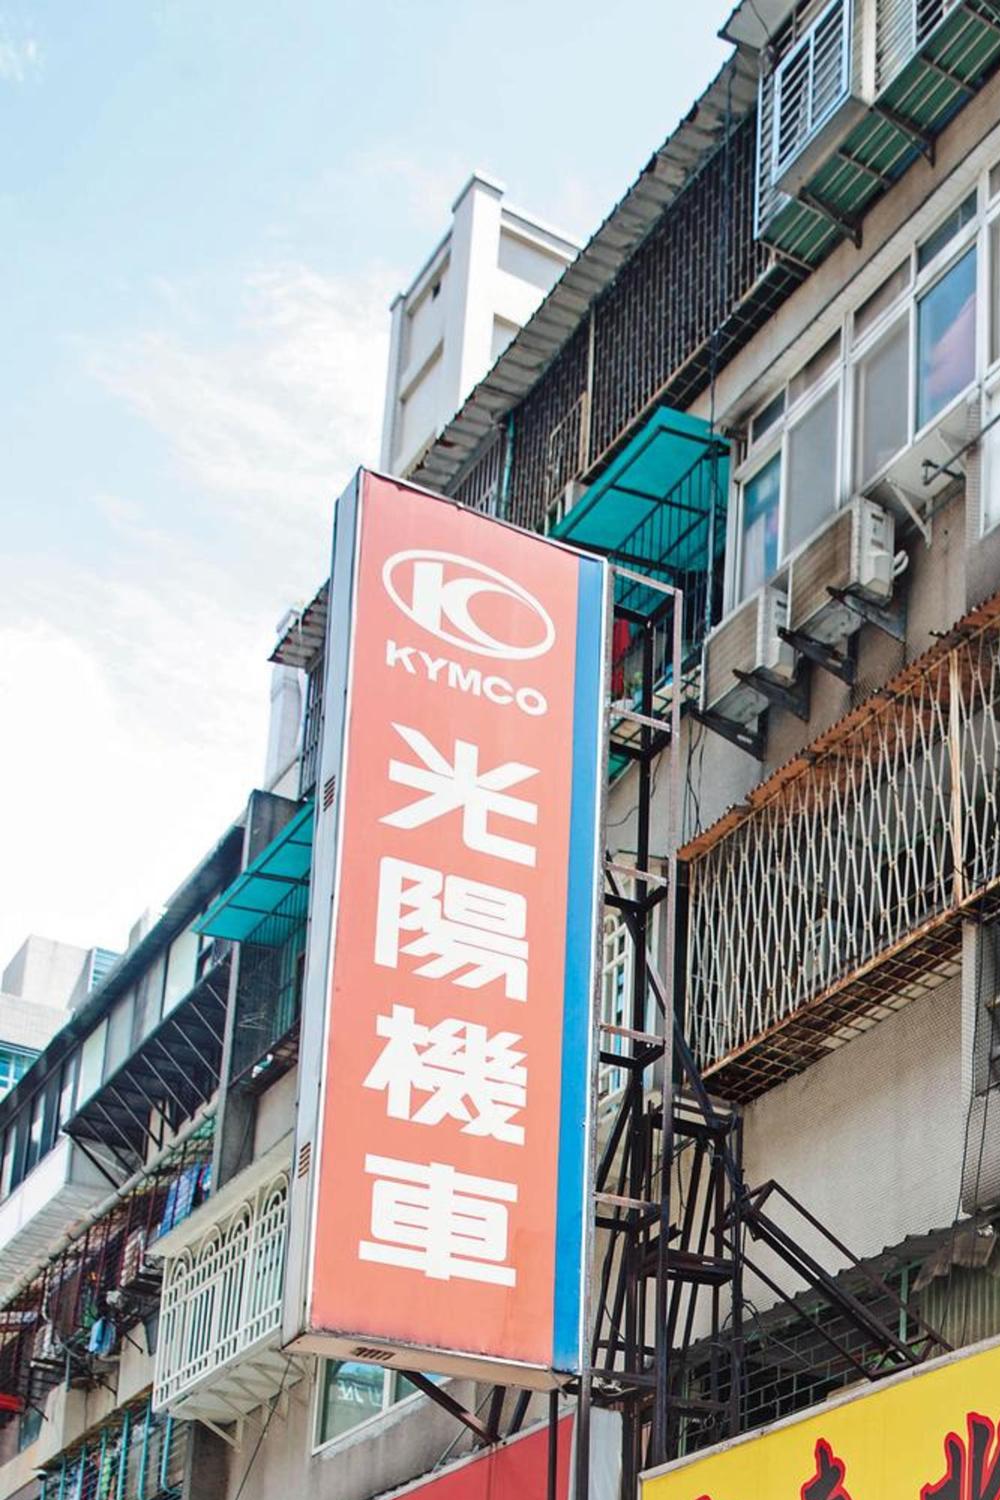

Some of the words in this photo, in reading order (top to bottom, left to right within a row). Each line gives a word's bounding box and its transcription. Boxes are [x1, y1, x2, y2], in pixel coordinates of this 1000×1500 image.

[385, 638, 549, 719] KYMCO
[357, 721, 541, 1288] 光陽機車
